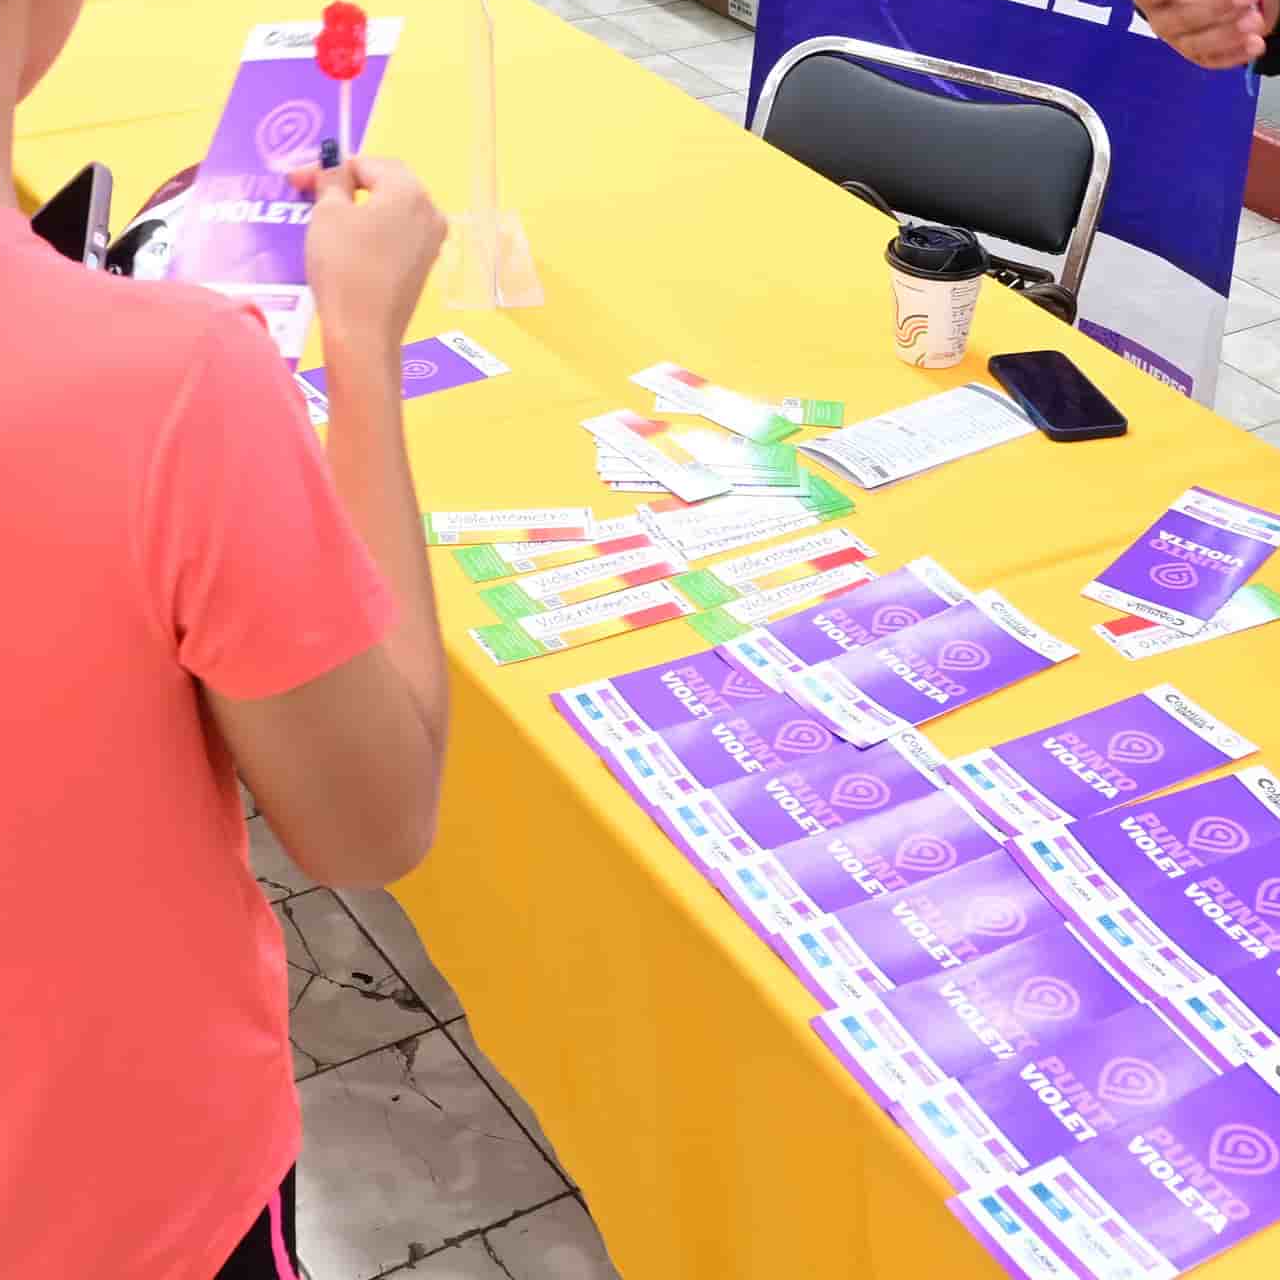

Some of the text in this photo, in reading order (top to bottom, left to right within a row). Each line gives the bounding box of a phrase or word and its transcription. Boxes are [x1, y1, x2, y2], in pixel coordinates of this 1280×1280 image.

[1149, 538, 1241, 577] PUNTO
[1159, 530, 1245, 568] VIOLETA
[875, 647, 951, 705] VIOLETA
[1042, 737, 1119, 800] VIOLETA
[1057, 732, 1138, 792] PUNTO
[1184, 882, 1271, 959] VIOLETA
[1128, 1136, 1228, 1235] VIOLETA
[1145, 1127, 1251, 1221] PUNTO
